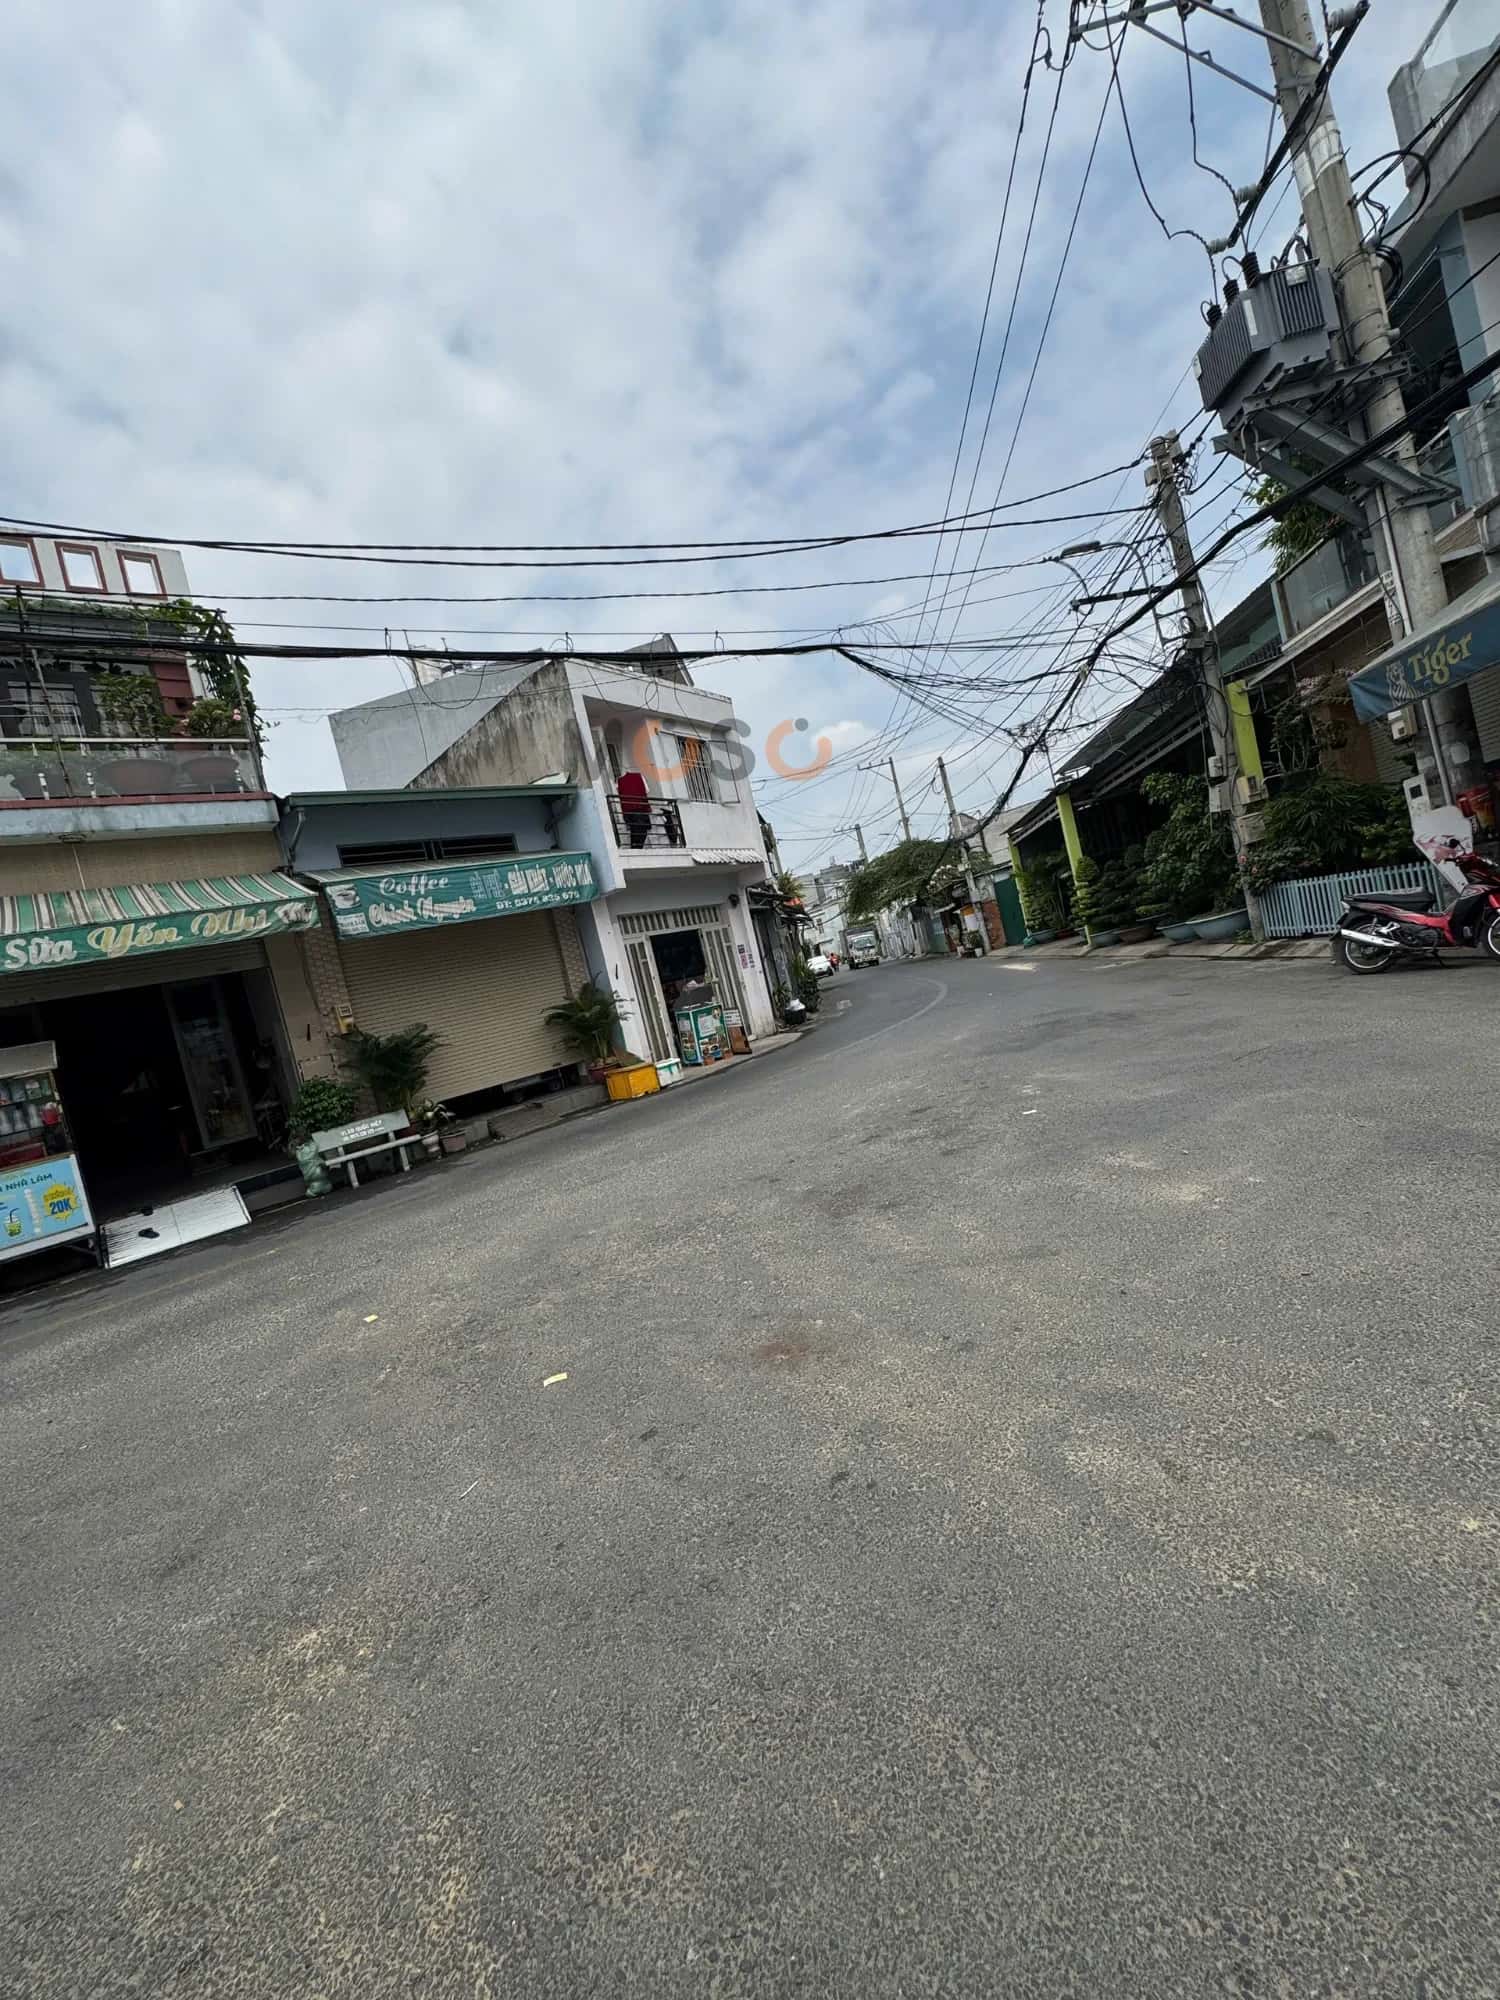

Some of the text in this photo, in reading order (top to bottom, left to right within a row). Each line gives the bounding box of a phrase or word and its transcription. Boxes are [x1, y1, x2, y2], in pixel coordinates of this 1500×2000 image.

[1408, 632, 1473, 684] Tiger
[379, 875, 449, 896] Coffee
[4, 908, 272, 970] Sữa Yến Nhi
[49, 1198, 72, 1215] 20K
